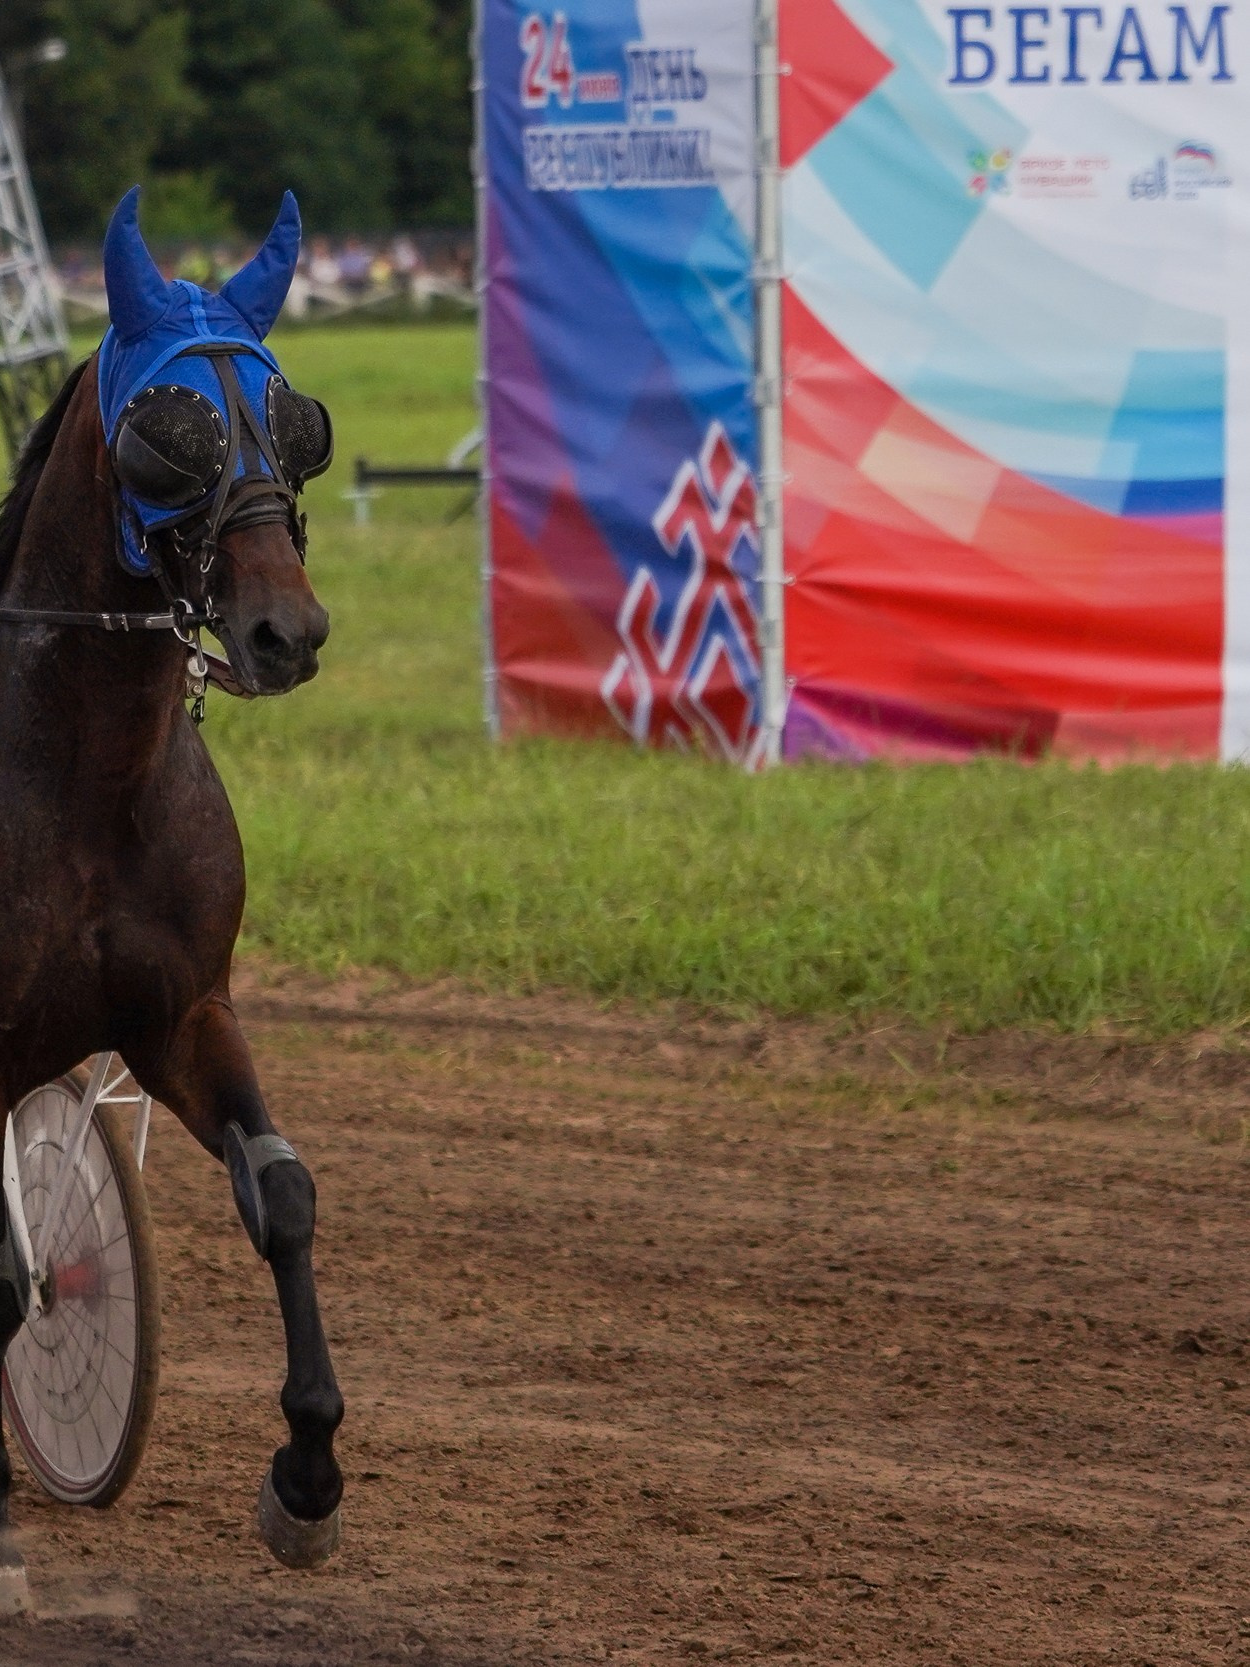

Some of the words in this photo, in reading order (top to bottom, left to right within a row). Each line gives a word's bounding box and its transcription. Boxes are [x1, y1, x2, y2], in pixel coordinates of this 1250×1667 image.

[521, 12, 573, 107] 24
[628, 48, 708, 104] ДЕНЬ
[947, 5, 1233, 85] БЕГАМ
